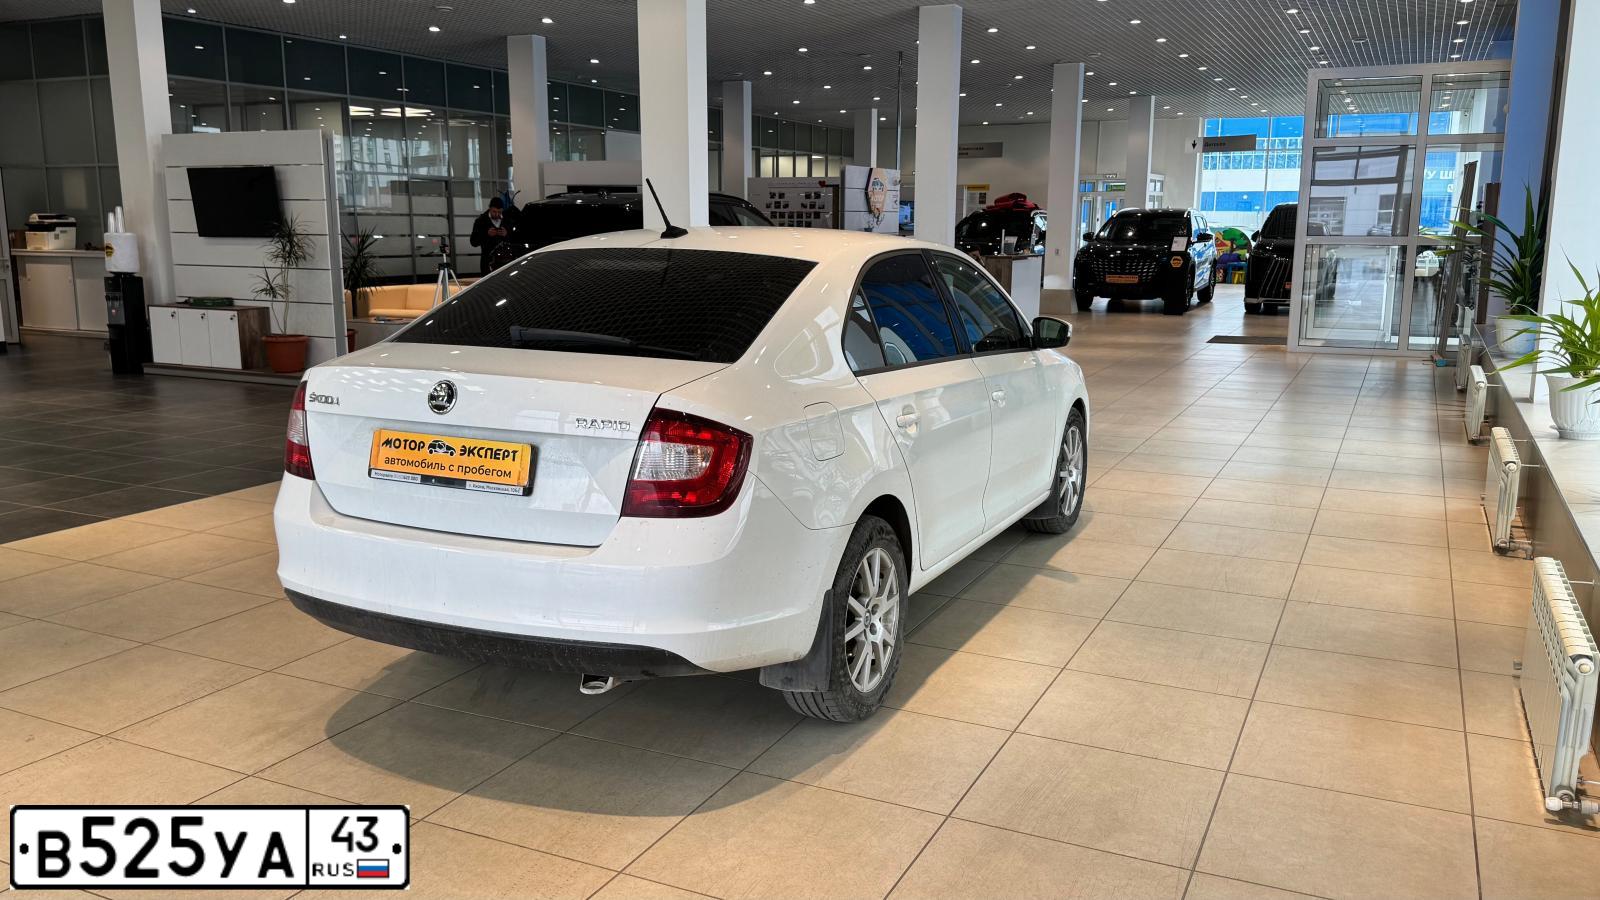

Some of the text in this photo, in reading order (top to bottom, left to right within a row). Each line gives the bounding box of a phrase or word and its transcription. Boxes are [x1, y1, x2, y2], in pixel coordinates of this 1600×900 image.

[575, 417, 631, 432] RAPID
[381, 438, 519, 462] МОТОР ЭКСПЕРТ
[384, 456, 512, 479] автомобиль с пробегом
